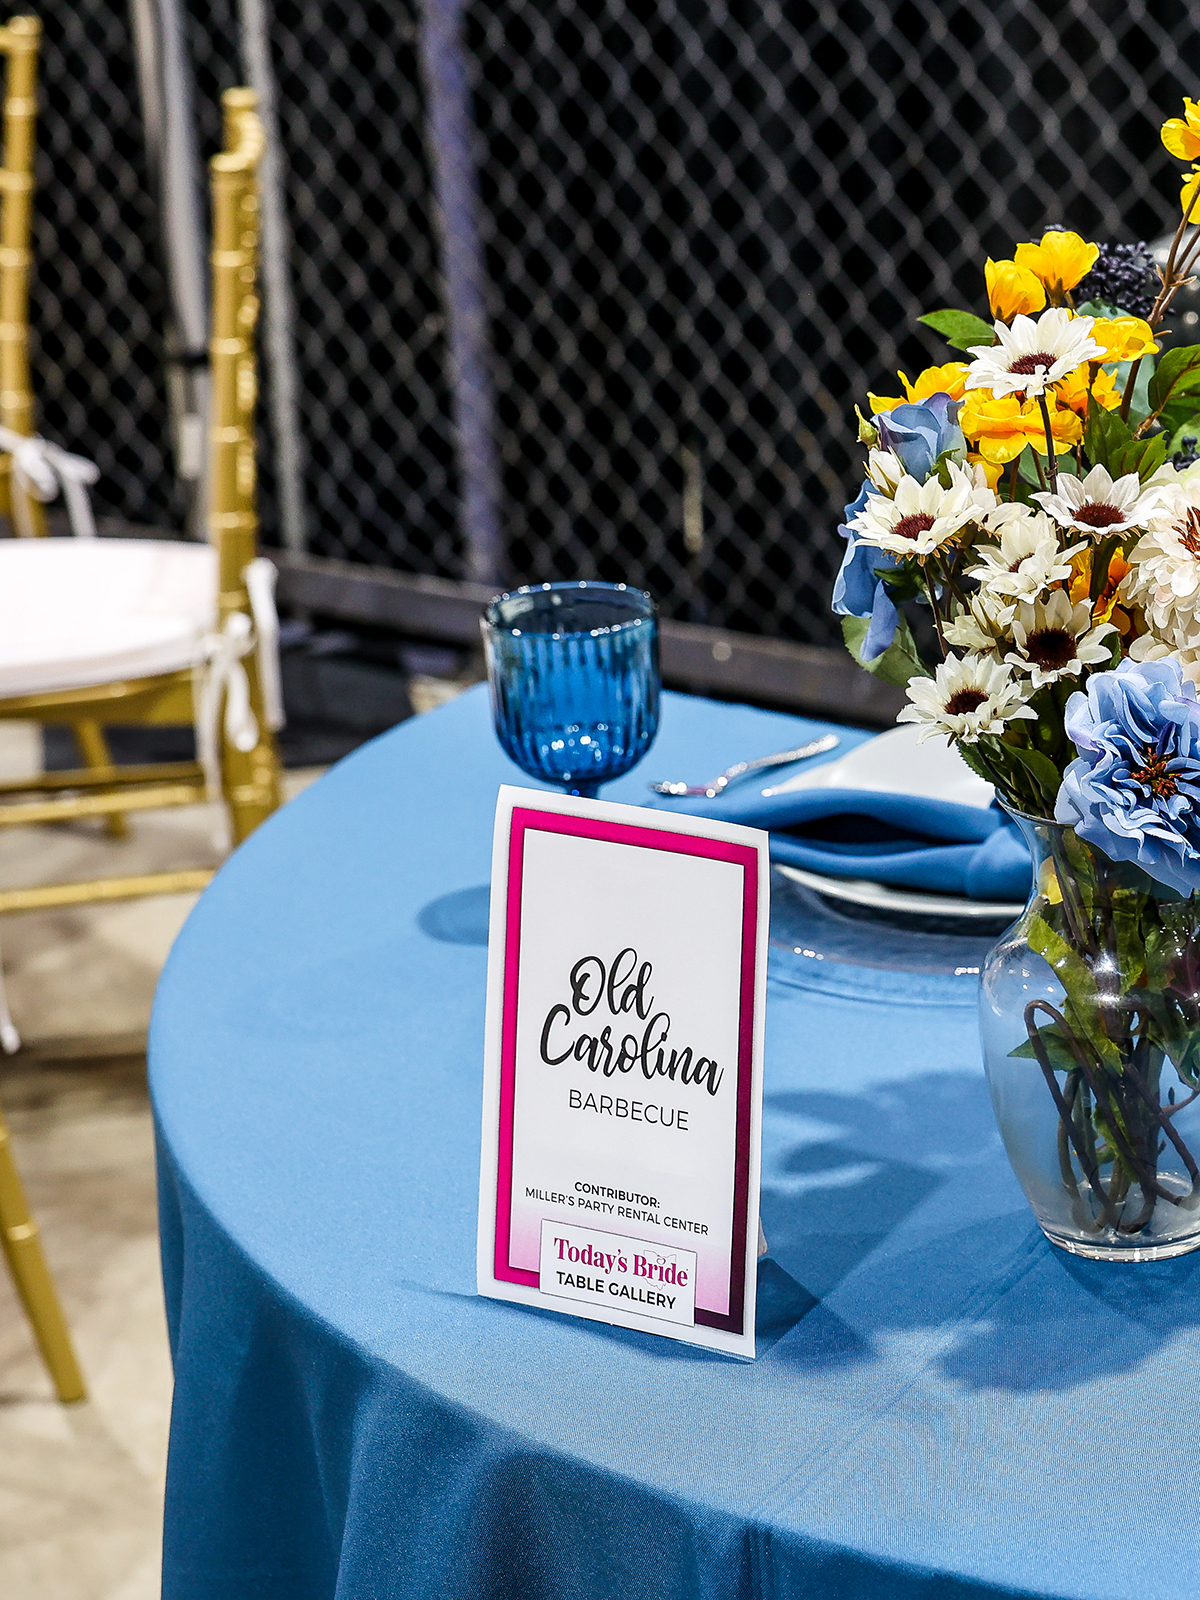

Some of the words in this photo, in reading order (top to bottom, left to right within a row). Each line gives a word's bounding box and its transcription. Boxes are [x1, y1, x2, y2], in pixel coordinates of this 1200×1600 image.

[570, 947, 654, 1020] Old
[540, 1003, 724, 1096] Carolina
[569, 1089, 689, 1131] BARBECUE
[525, 1187, 575, 1206] MILLER'S
[578, 1198, 615, 1214] PARTY
[618, 1207, 660, 1225] RENTAL
[663, 1216, 709, 1236] CENTER
[574, 1181, 661, 1209] CONTRIBUTOR:
[554, 1237, 628, 1274] Today's
[633, 1252, 689, 1287] Bride
[556, 1271, 604, 1293] TABLE
[608, 1283, 677, 1310] GALLERY
